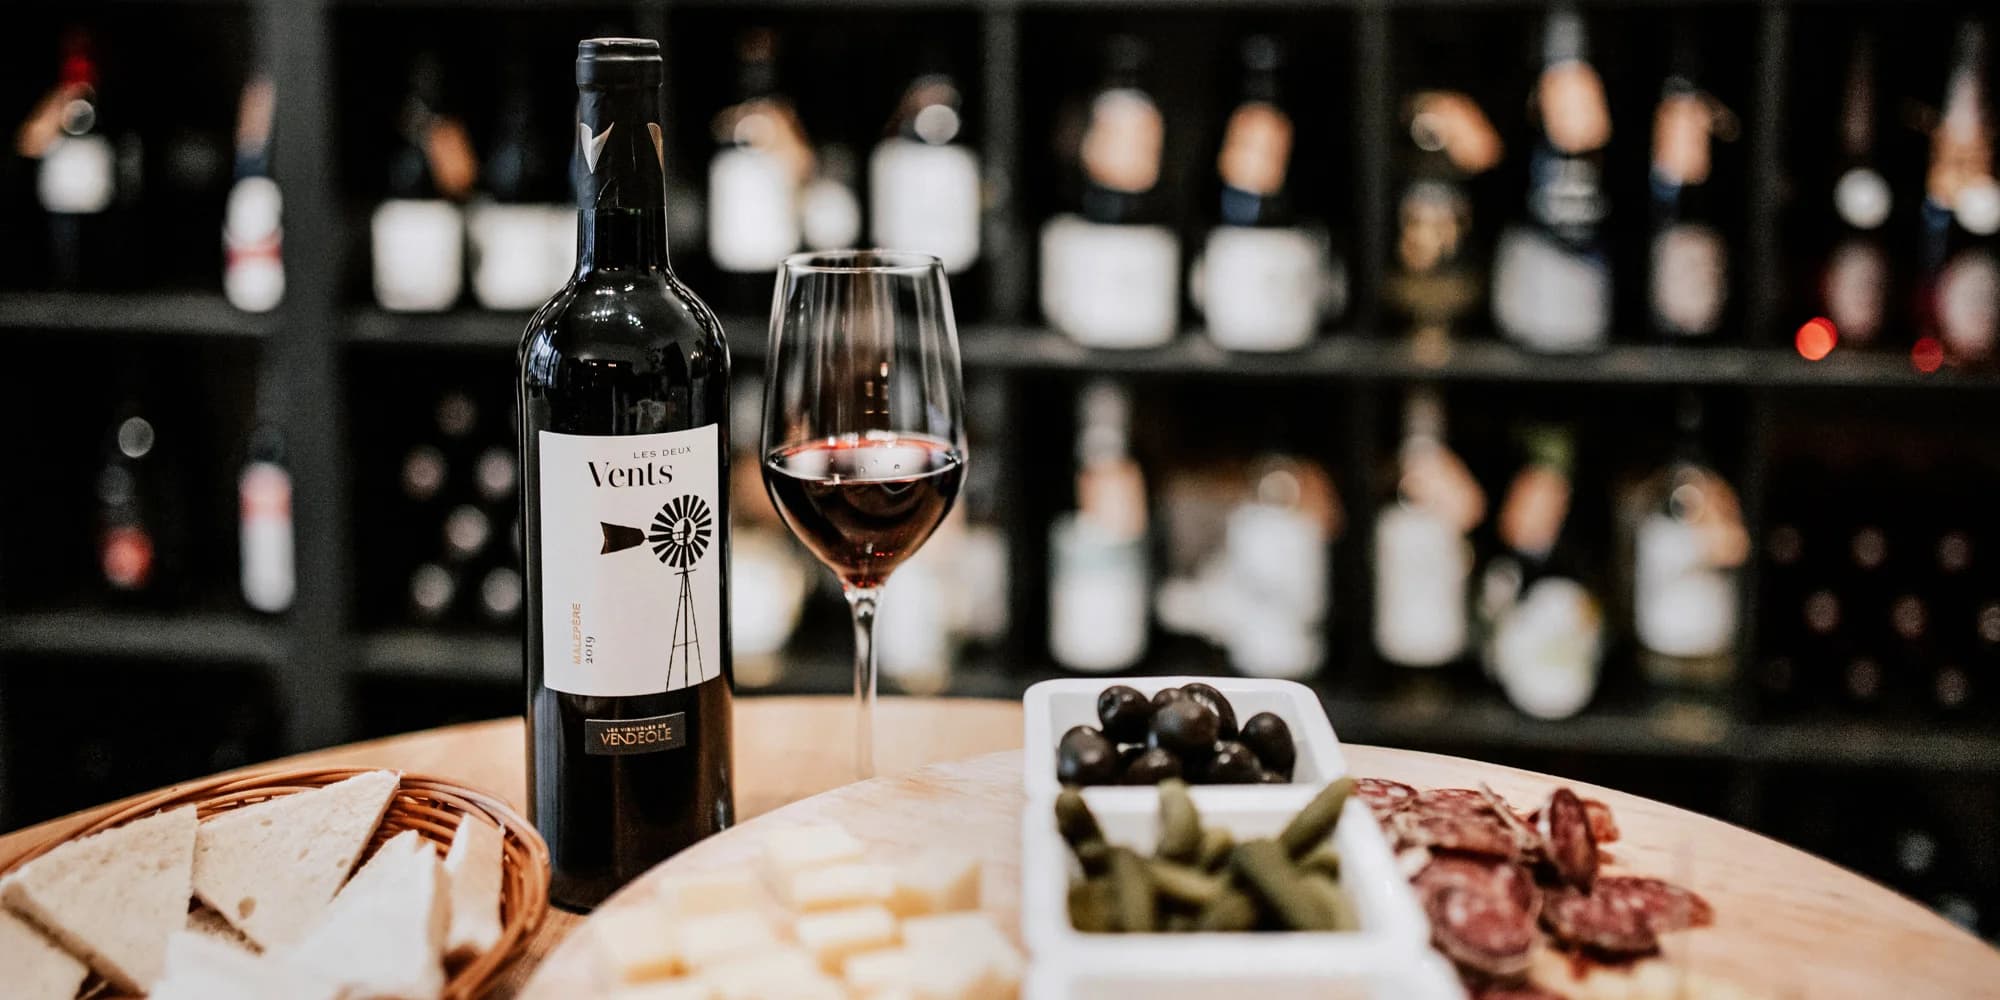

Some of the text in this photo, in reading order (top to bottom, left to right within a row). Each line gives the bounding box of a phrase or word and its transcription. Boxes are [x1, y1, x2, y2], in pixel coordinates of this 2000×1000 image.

[633, 446, 692, 459] LES DEUX
[588, 461, 673, 488] Vents
[585, 636, 595, 664] 2019
[600, 727, 673, 745] VENDEOLE
